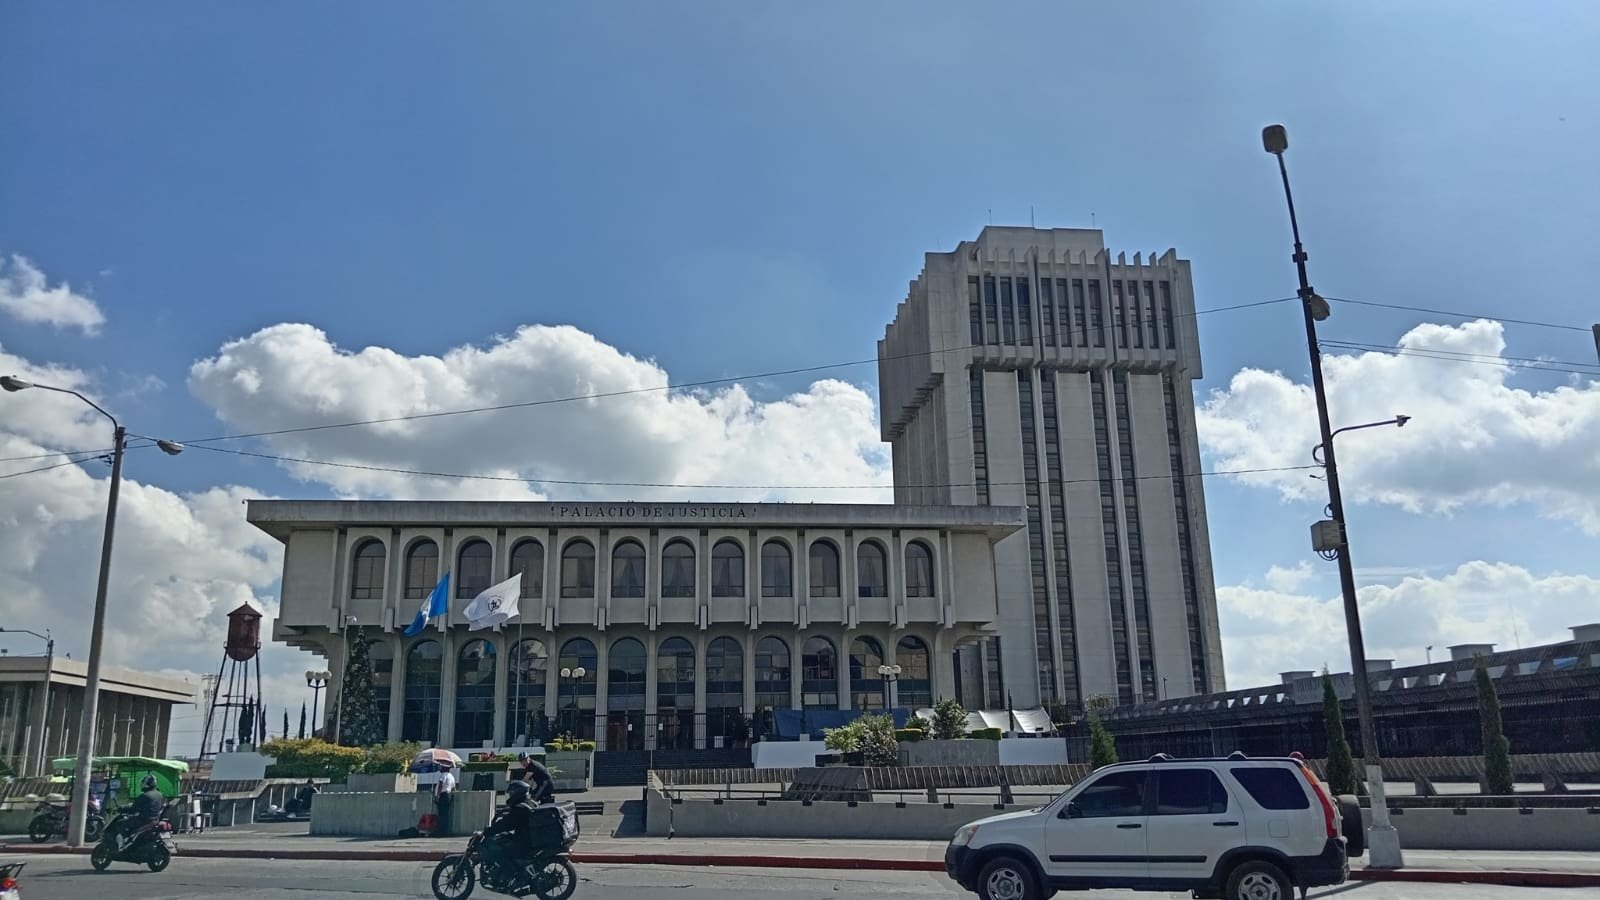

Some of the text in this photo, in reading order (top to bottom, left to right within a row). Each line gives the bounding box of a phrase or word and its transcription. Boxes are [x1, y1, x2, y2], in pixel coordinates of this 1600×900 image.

[560, 506, 746, 518] PALACIO DE JUSTICIA
